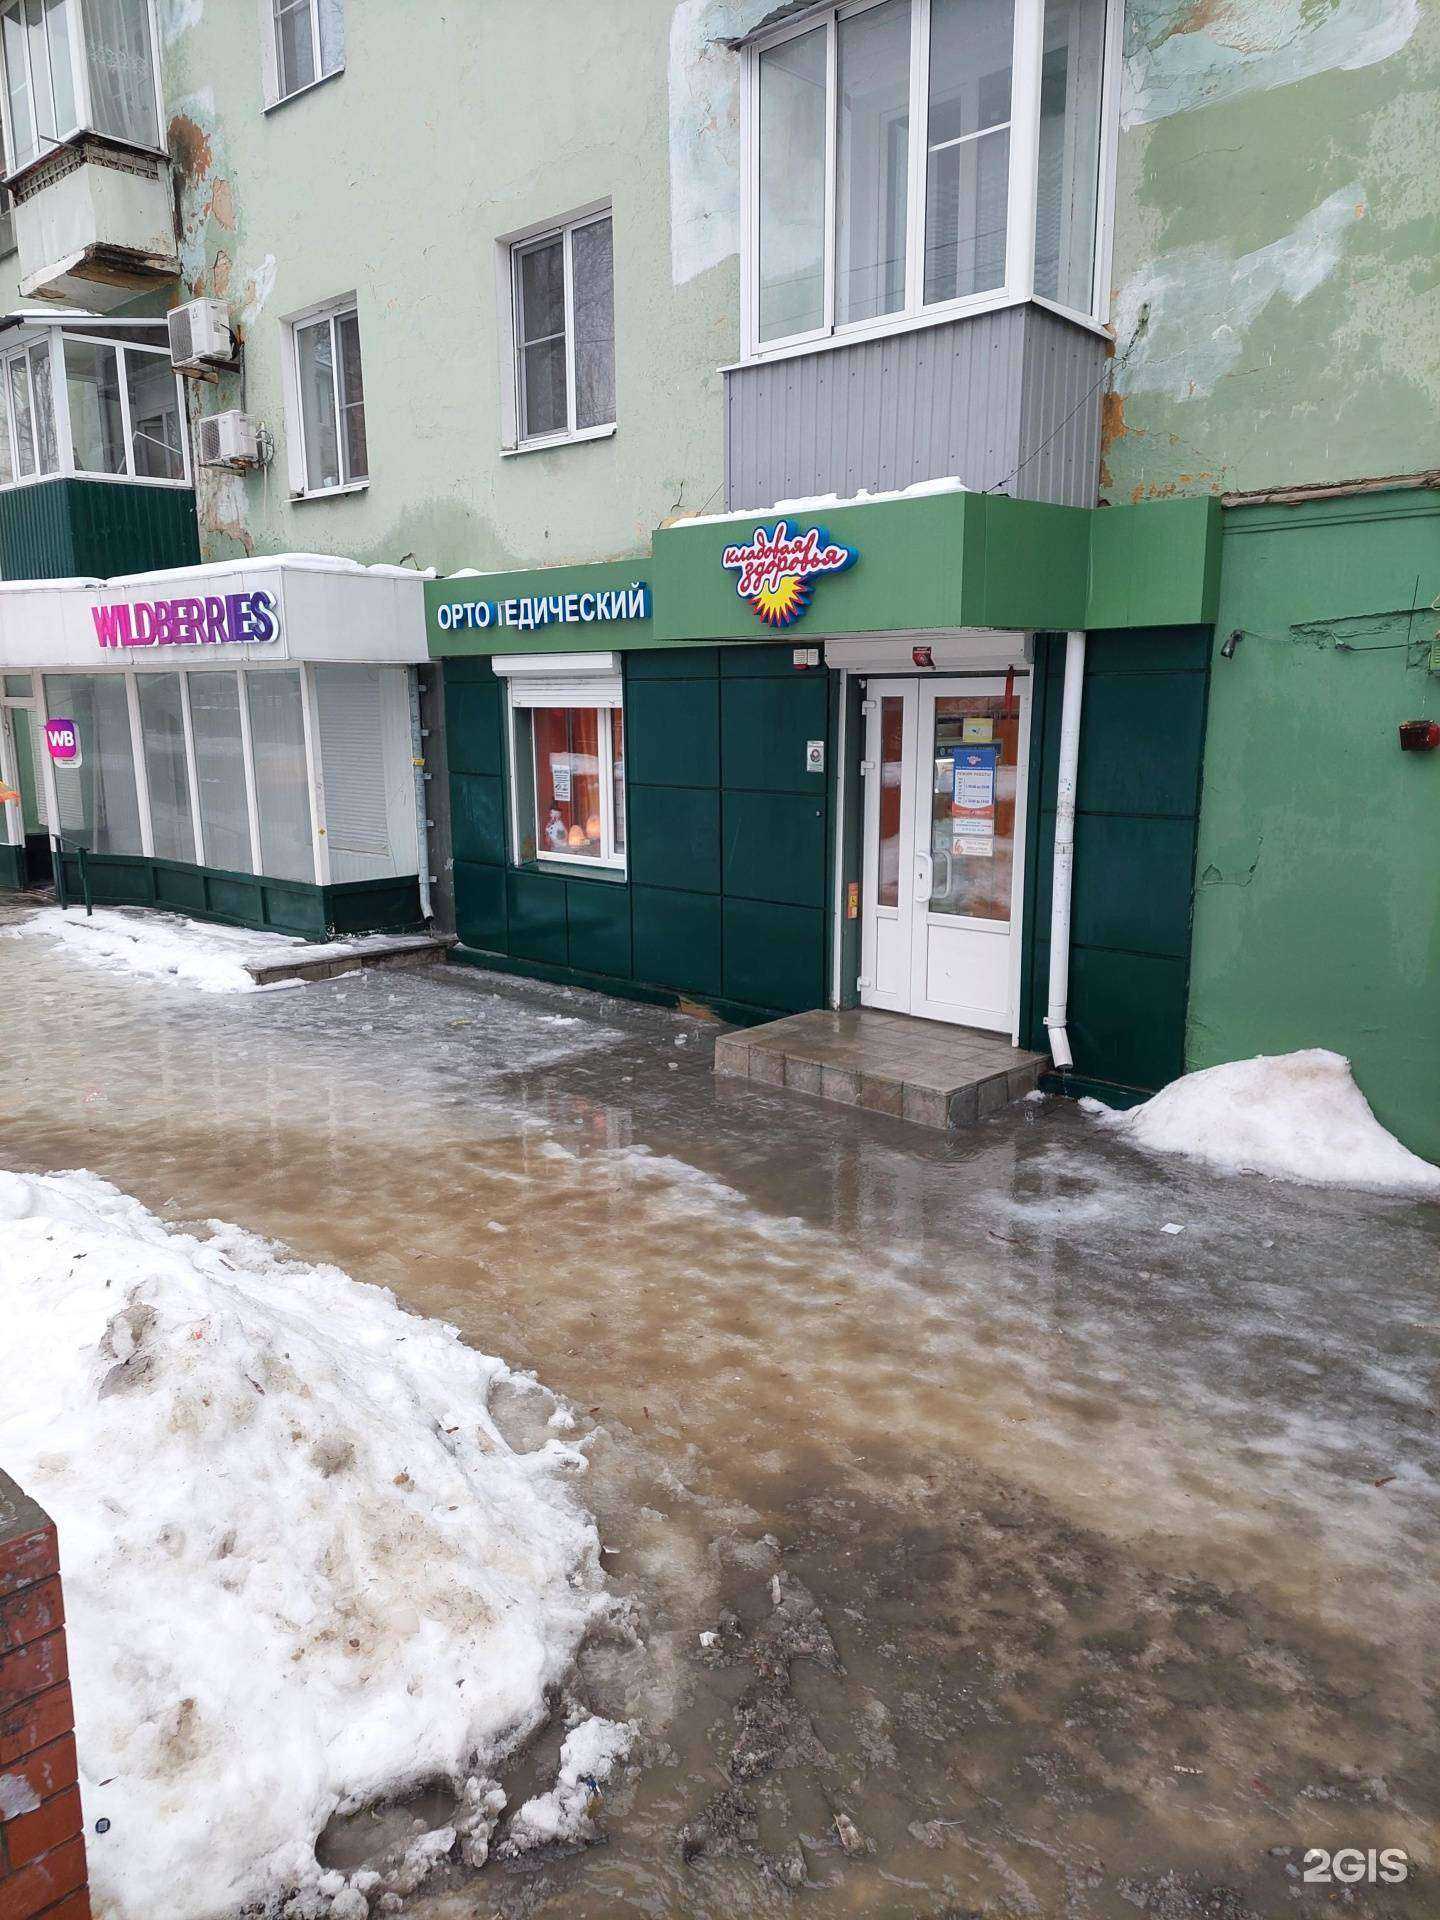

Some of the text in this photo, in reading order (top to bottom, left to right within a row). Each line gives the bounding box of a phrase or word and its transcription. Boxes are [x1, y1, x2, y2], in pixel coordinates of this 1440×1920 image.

[740, 532, 845, 593] здоровья
[91, 591, 278, 648] WILDBERRIES
[47, 730, 75, 747] WB
